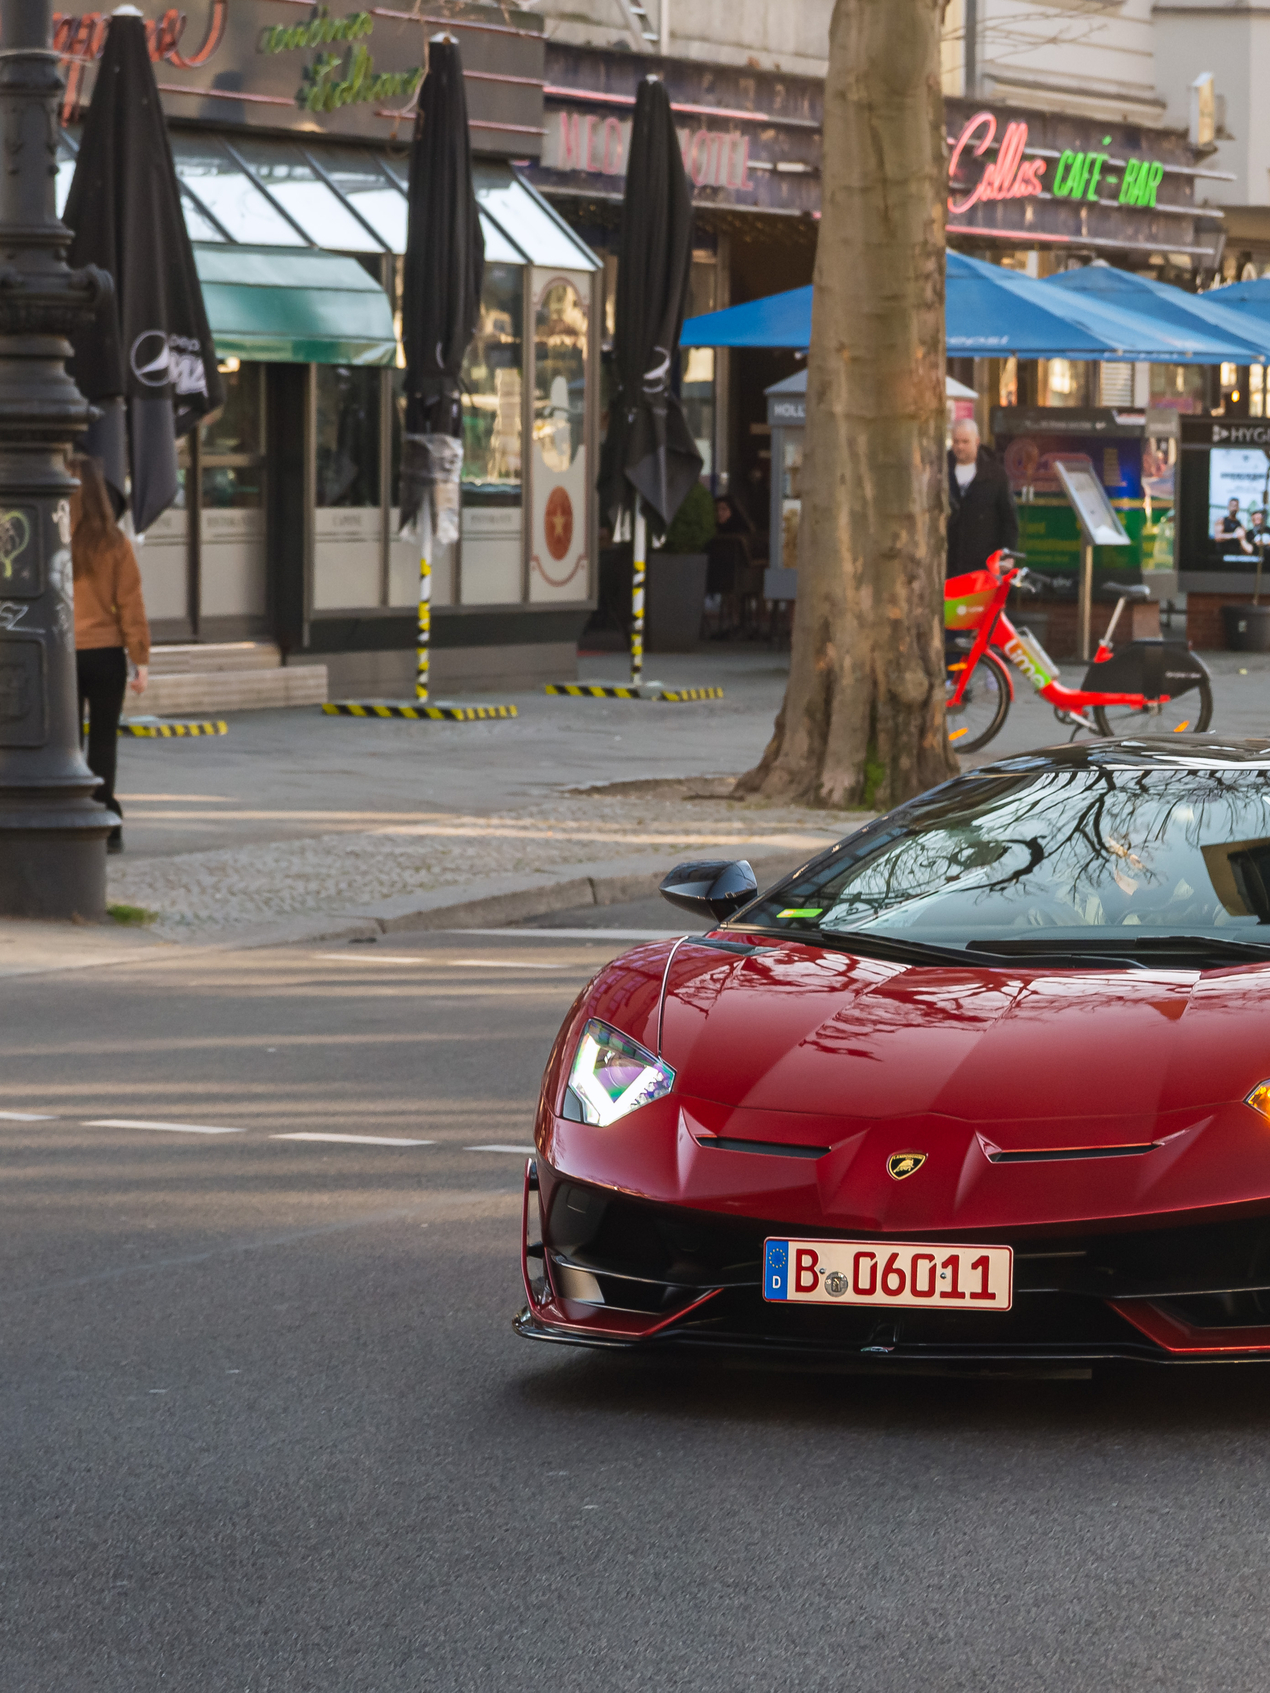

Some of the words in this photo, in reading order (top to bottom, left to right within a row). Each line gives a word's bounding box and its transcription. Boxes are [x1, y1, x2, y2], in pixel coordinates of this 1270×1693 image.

[774, 404, 806, 418] HOLL
[1004, 638, 1045, 689] Lime
[772, 1275, 782, 1289] D
[795, 1248, 820, 1293] B
[853, 1251, 997, 1301] 06011
